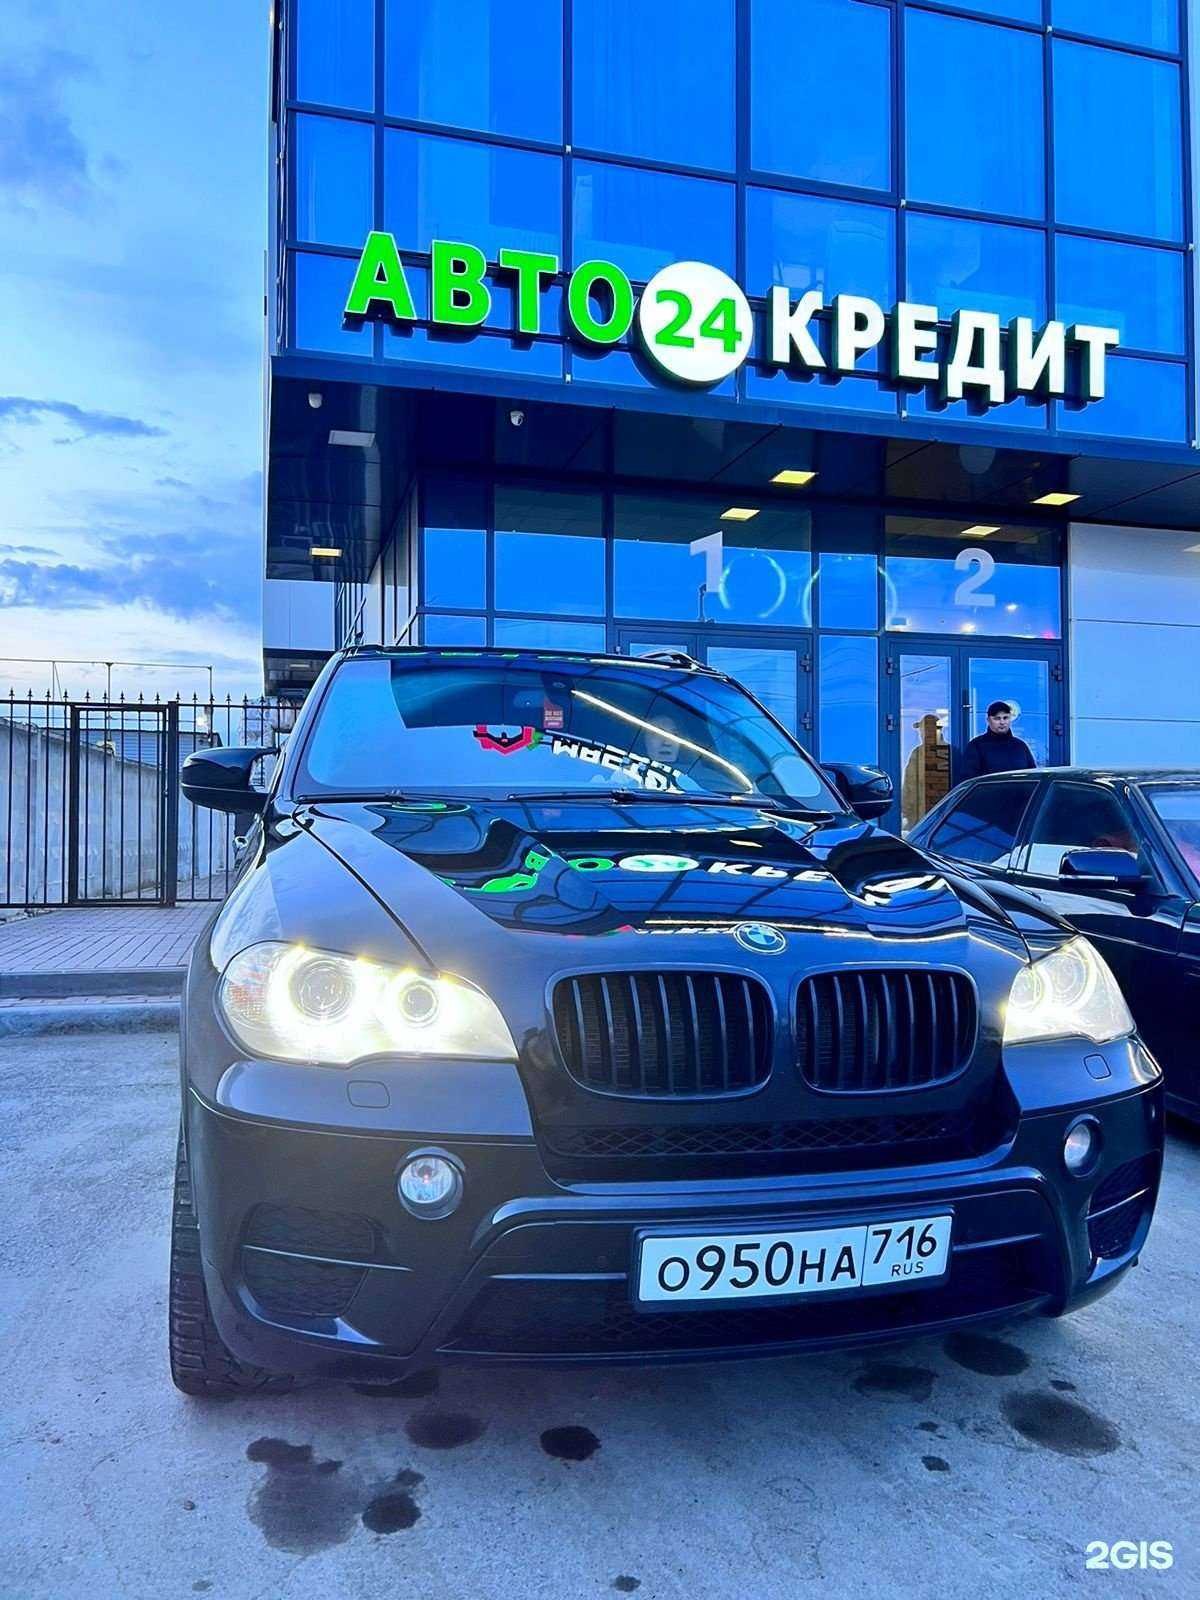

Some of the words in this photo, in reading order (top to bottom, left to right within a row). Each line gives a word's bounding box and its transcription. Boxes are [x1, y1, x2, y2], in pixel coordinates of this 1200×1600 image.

[345, 231, 634, 344] АВТО
[654, 290, 742, 353] 24
[768, 285, 1120, 403] КРЕДИТ
[689, 530, 724, 593] 1
[954, 547, 996, 607] 2
[657, 1241, 857, 1293] О950НА
[872, 1223, 938, 1265] 716
[890, 1260, 925, 1277] RUS
